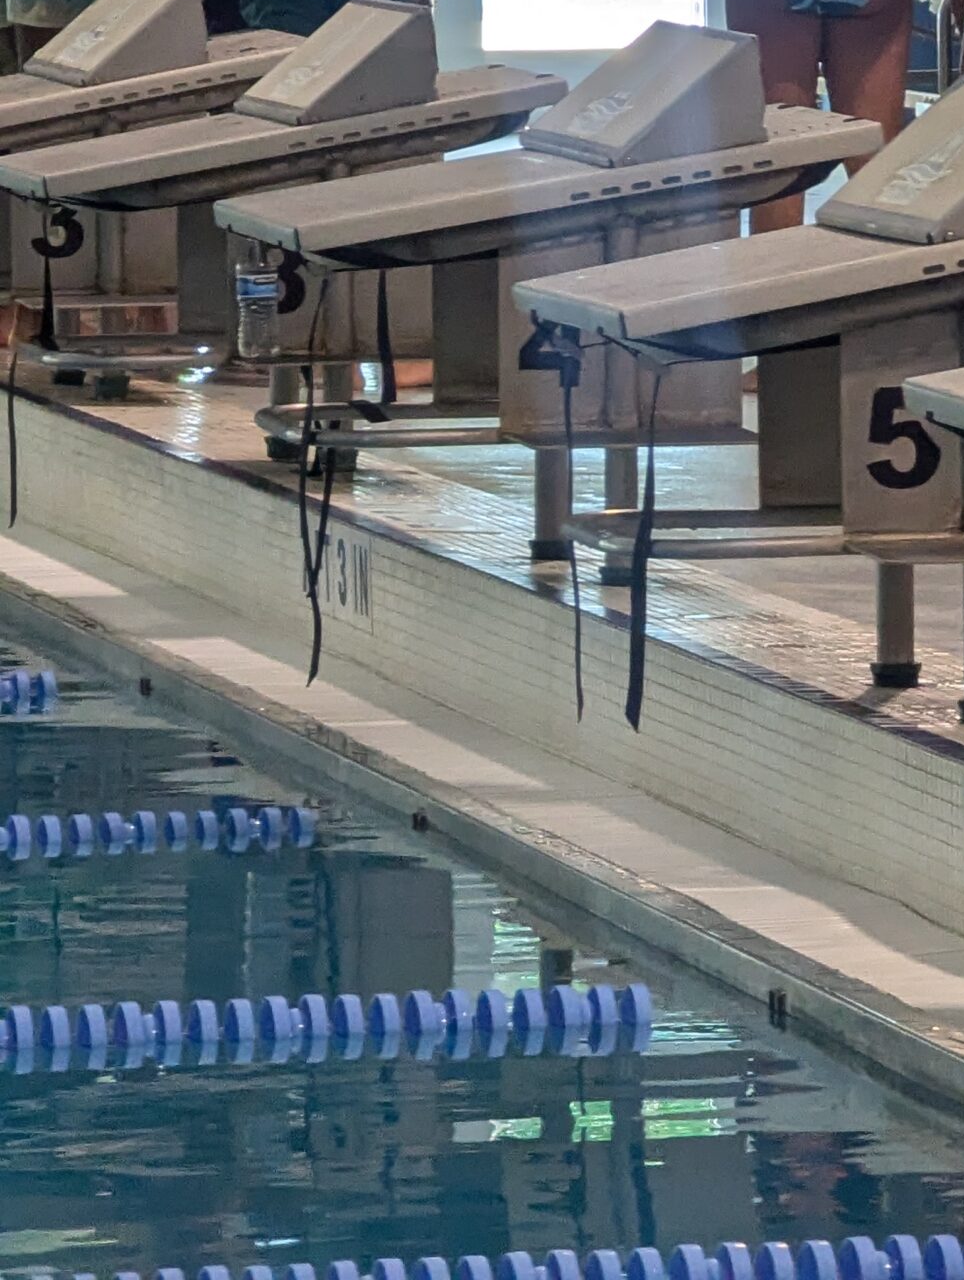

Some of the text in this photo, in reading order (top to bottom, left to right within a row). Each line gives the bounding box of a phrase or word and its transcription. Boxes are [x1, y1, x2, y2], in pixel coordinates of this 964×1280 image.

[518, 319, 581, 387] 4
[866, 386, 941, 489] 5
[337, 538, 346, 607] 3
[353, 544, 368, 616] IN
